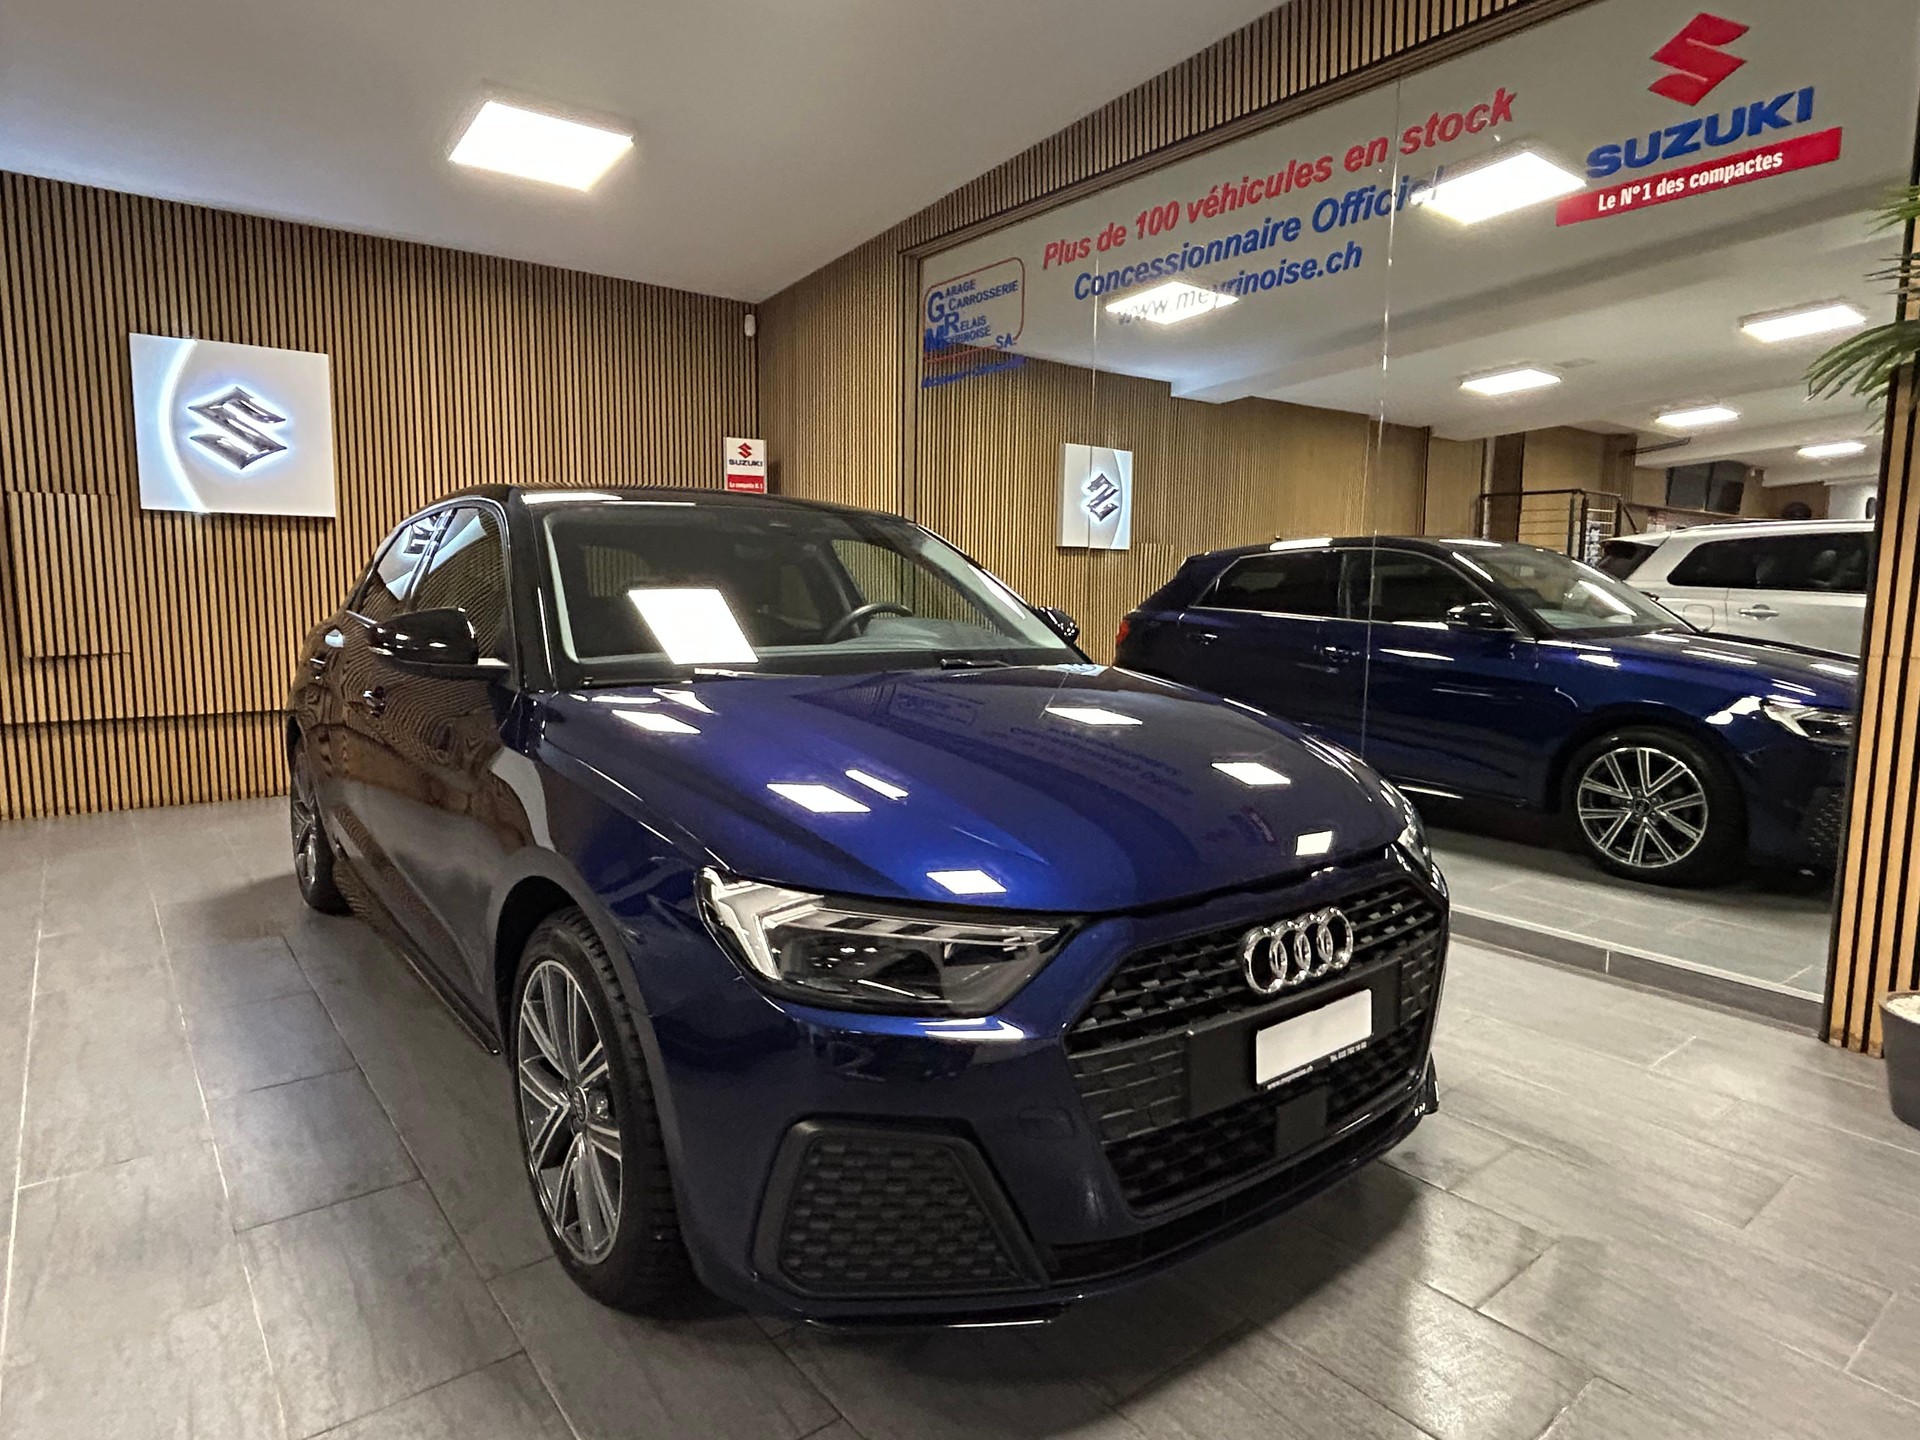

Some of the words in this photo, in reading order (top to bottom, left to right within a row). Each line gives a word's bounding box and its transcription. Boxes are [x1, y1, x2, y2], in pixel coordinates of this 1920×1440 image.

[1586, 86, 1815, 179] SUZUKI
[1042, 236, 1091, 271] Plus
[1096, 222, 1126, 253] de
[1135, 201, 1179, 240] 100
[1188, 156, 1333, 222] véhicules
[1344, 137, 1388, 171] en
[1402, 87, 1517, 154] stock
[1598, 194, 1615, 211] Le
[1656, 176, 1685, 198] des
[1689, 151, 1784, 189] compactes
[1074, 217, 1301, 300] Concessionnaire
[948, 280, 1018, 312] CARROSSERIE
[729, 459, 763, 467] SUZUKI
